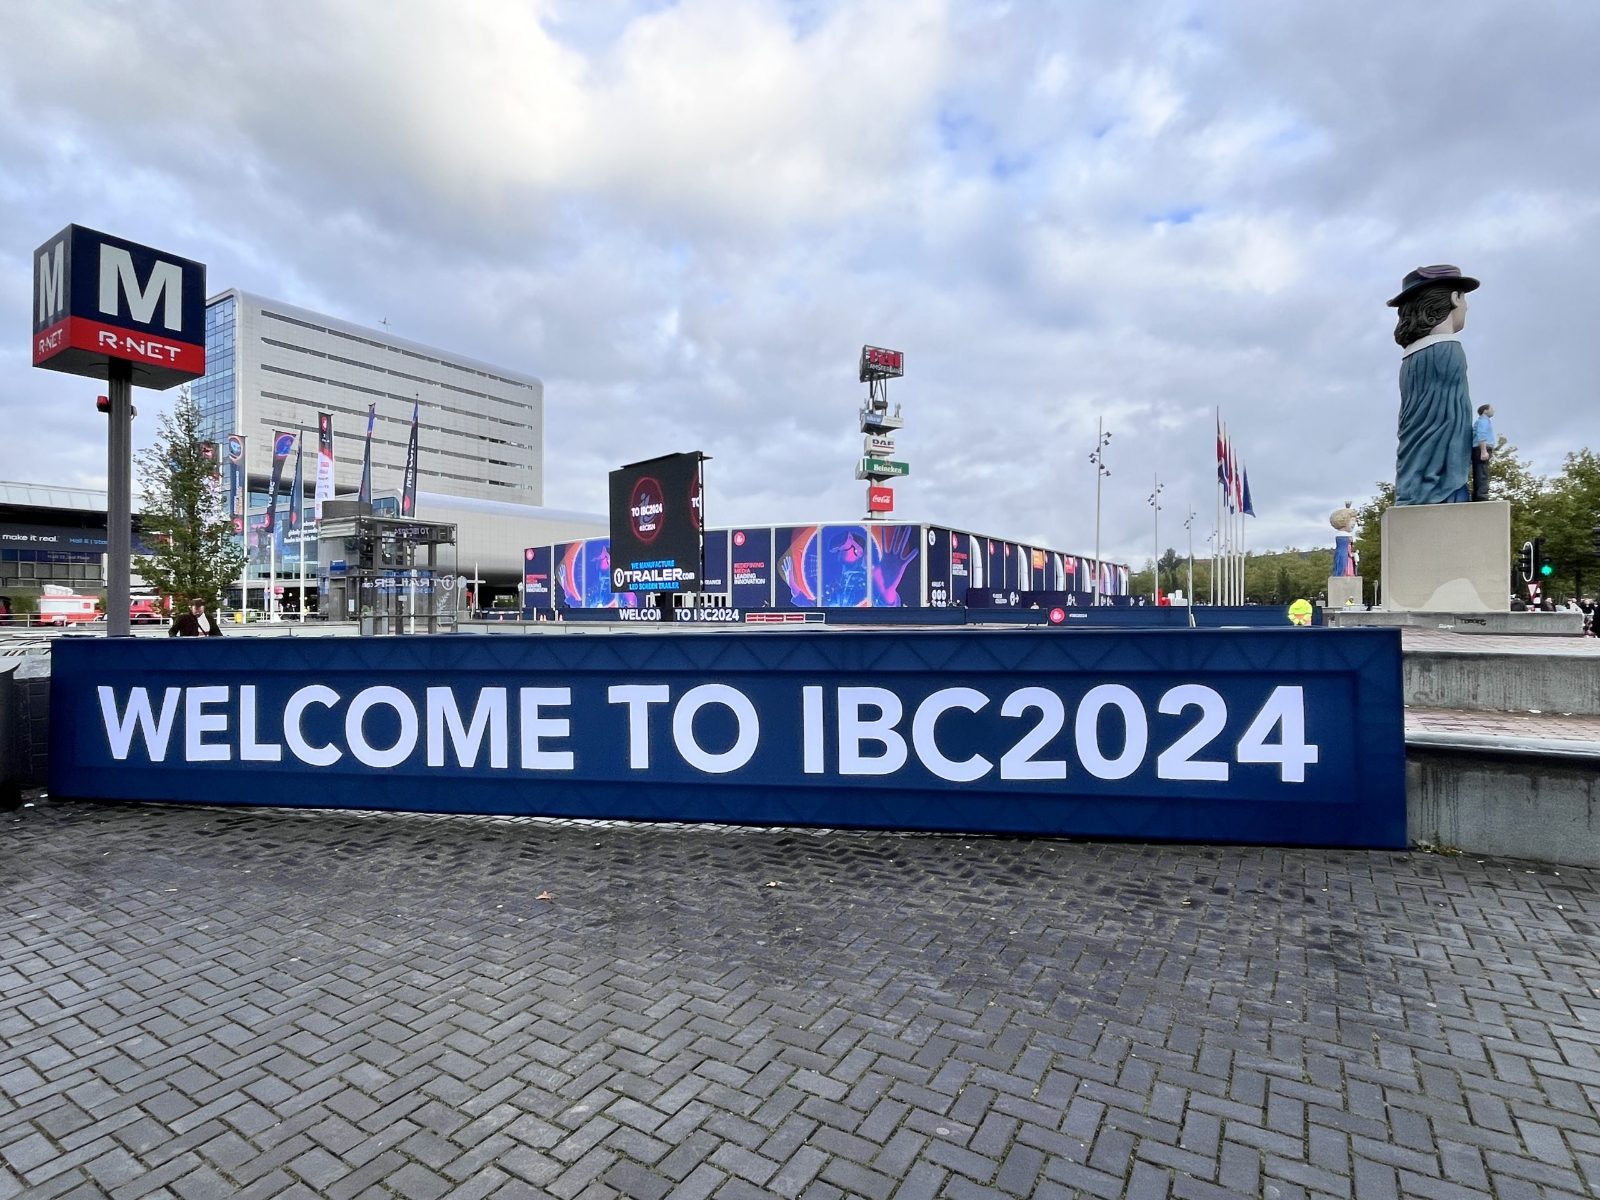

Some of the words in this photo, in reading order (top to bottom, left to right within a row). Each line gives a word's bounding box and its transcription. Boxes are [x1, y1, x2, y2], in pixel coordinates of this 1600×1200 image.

[40, 240, 63, 322] M
[99, 243, 182, 332] M
[873, 463, 903, 473] Heineken
[631, 507, 640, 517] TO
[674, 608, 691, 621] TO
[694, 608, 740, 621] IBC2024
[98, 685, 575, 770] WELCOME
[608, 684, 760, 773] TO
[803, 684, 1320, 783] IBC2024
